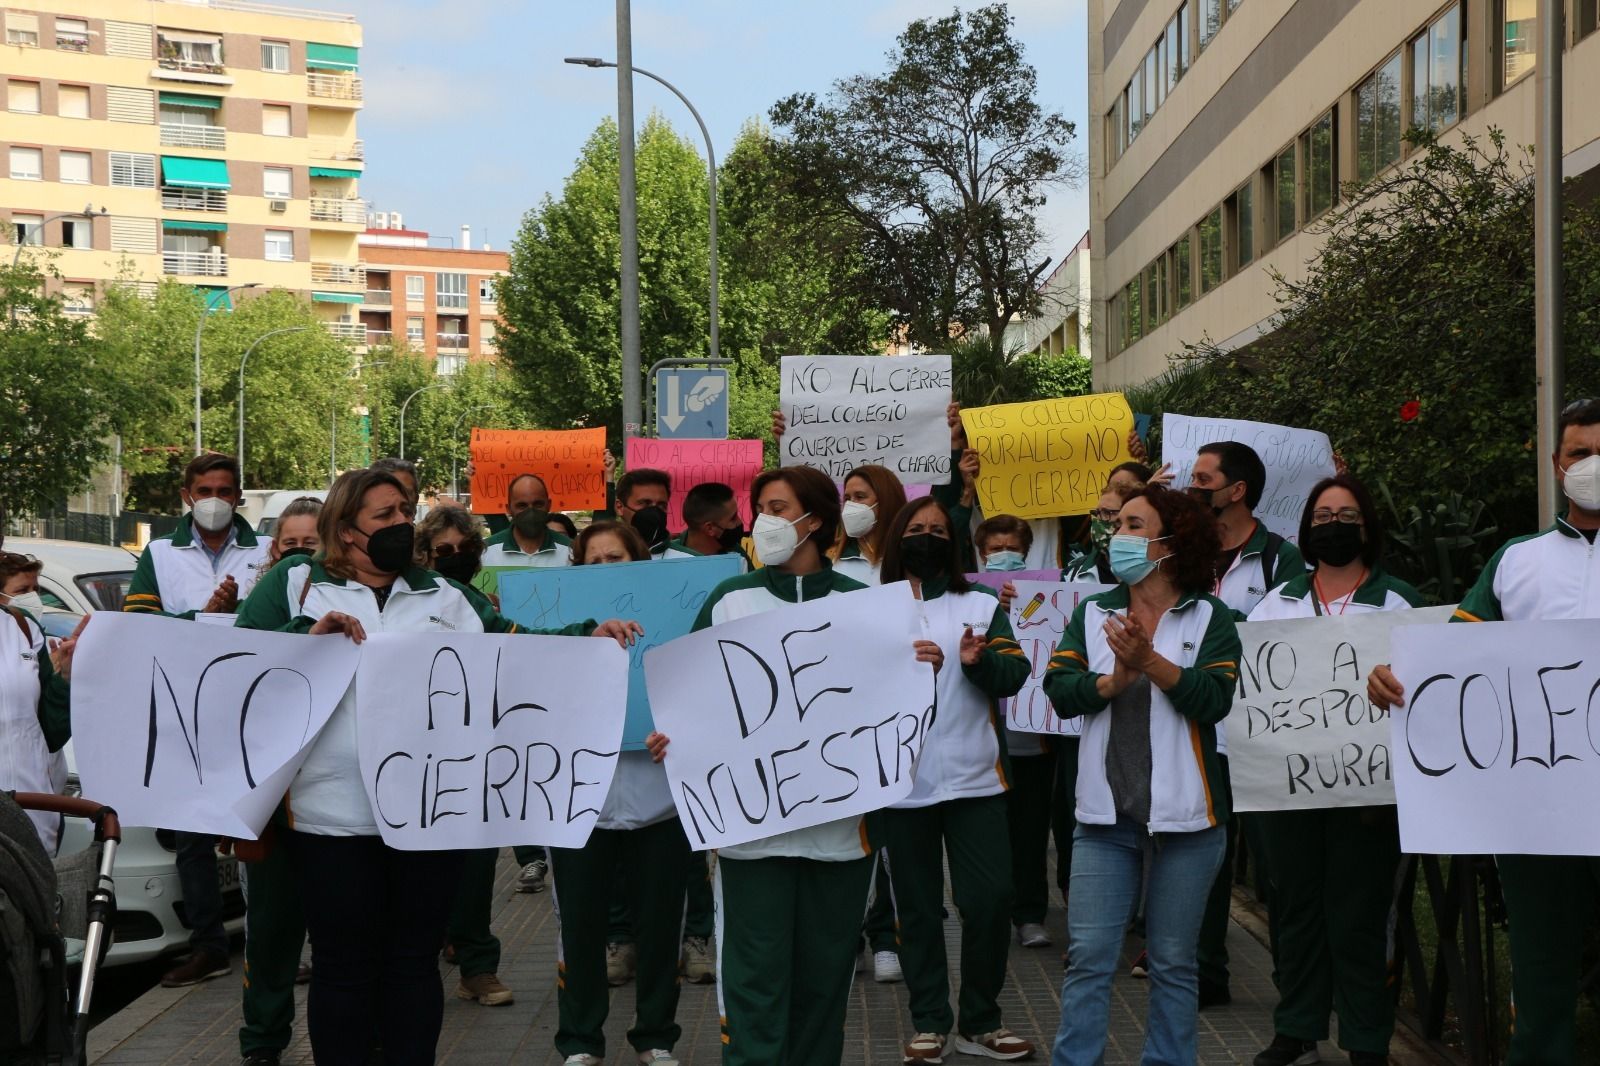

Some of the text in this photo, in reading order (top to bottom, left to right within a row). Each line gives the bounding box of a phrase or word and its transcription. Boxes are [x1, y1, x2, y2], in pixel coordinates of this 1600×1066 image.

[791, 362, 832, 395] NO
[850, 365, 888, 394] AL
[970, 395, 1126, 429] LOS COLEGIOS
[475, 445, 497, 463] DEL
[563, 446, 577, 460] DE
[583, 444, 600, 459] LA
[633, 442, 758, 464] NO AL CIERRE
[877, 434, 905, 450] DE
[976, 424, 1120, 465] RURALES NO
[898, 455, 952, 474] CHARCO
[980, 476, 1002, 512] SE
[718, 621, 853, 740] DE
[1239, 640, 1360, 700] NO A
[428, 646, 548, 731] AL
[143, 650, 312, 788] NO
